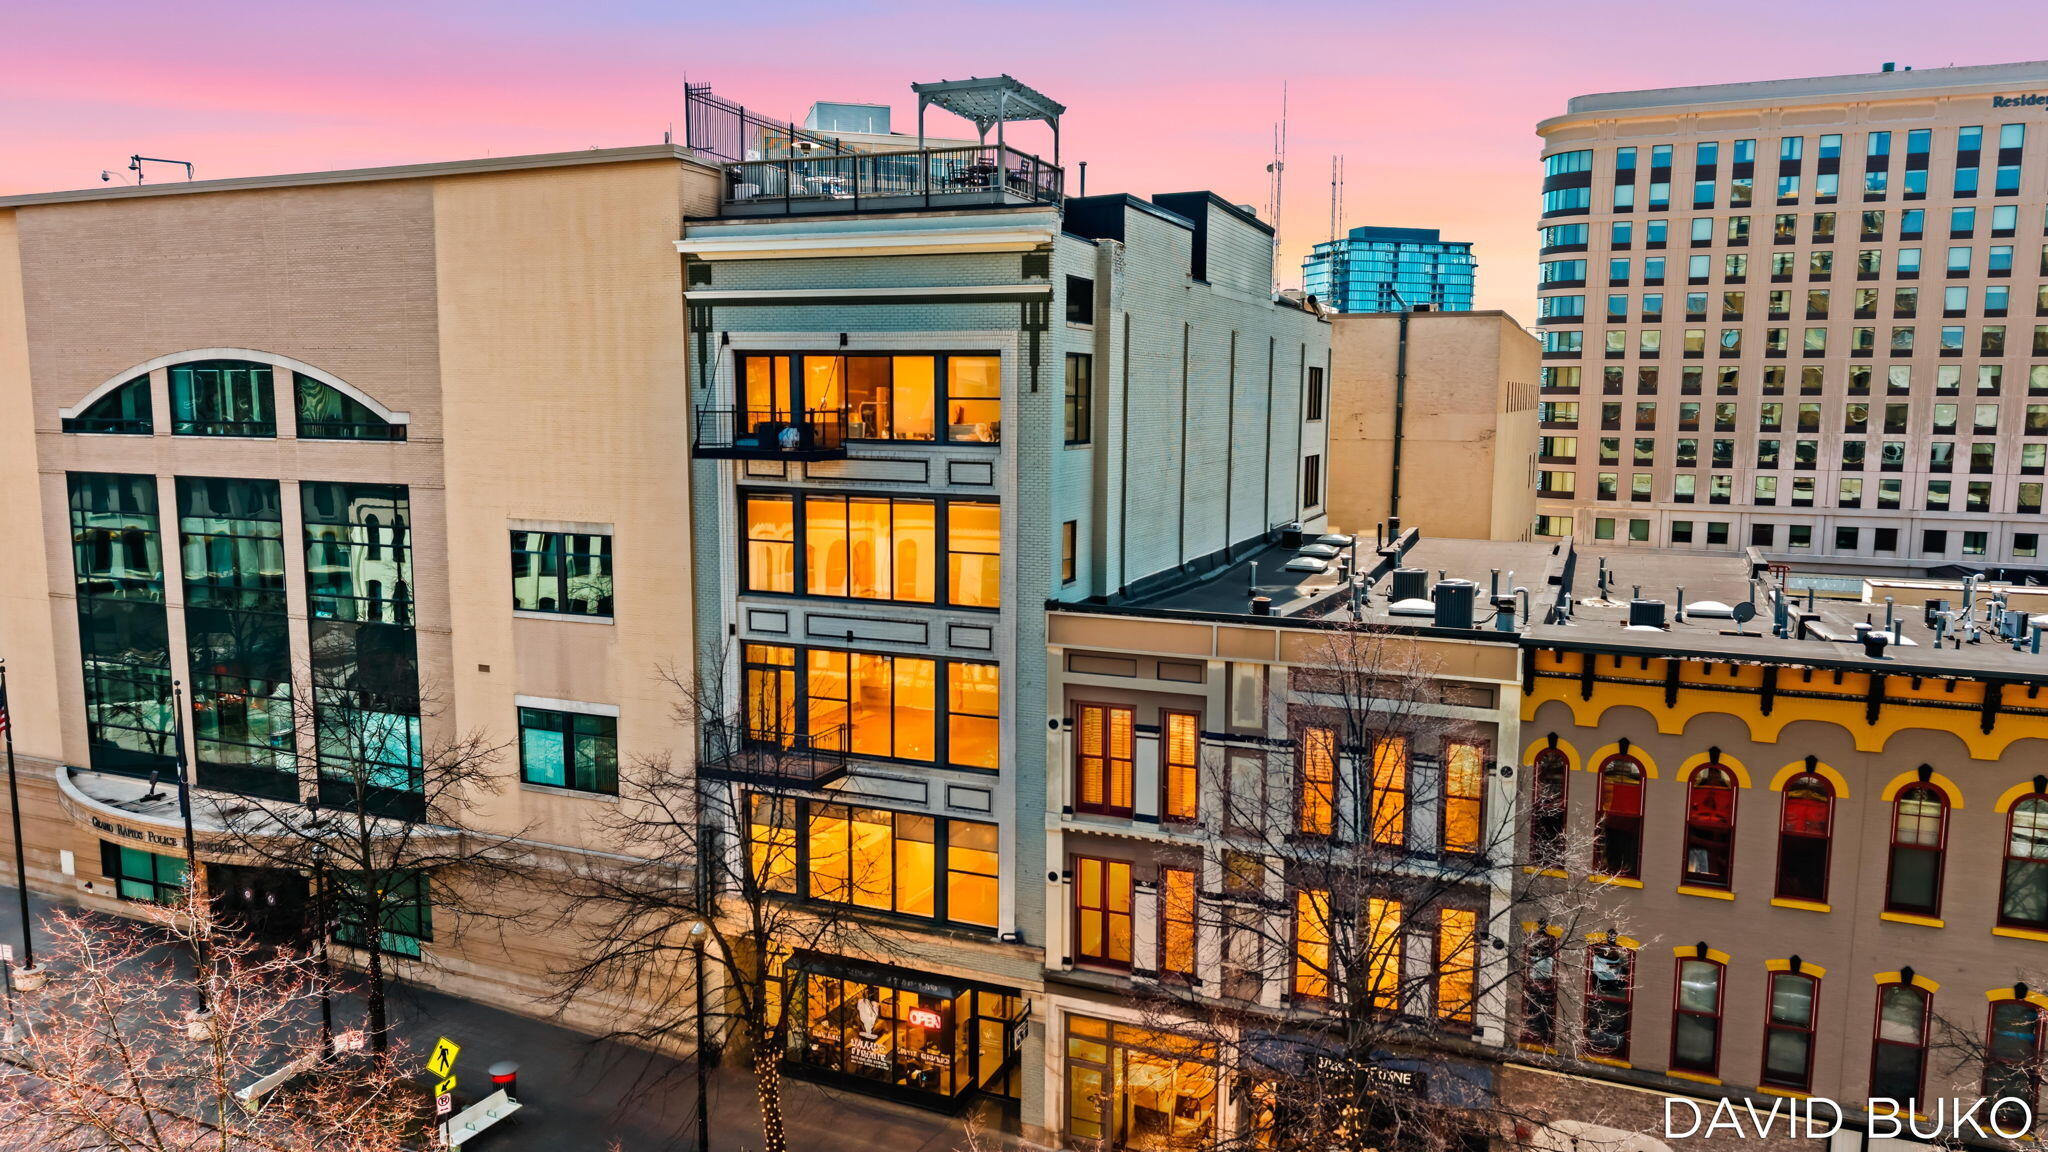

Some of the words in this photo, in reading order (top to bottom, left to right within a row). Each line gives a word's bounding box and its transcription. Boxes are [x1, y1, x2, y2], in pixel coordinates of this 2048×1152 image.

[1993, 94, 2048, 108] Reside
[92, 816, 113, 833] GRAND
[118, 824, 143, 840] RAPIDS
[148, 832, 177, 847] POLICE
[909, 1010, 941, 1029] OPEN
